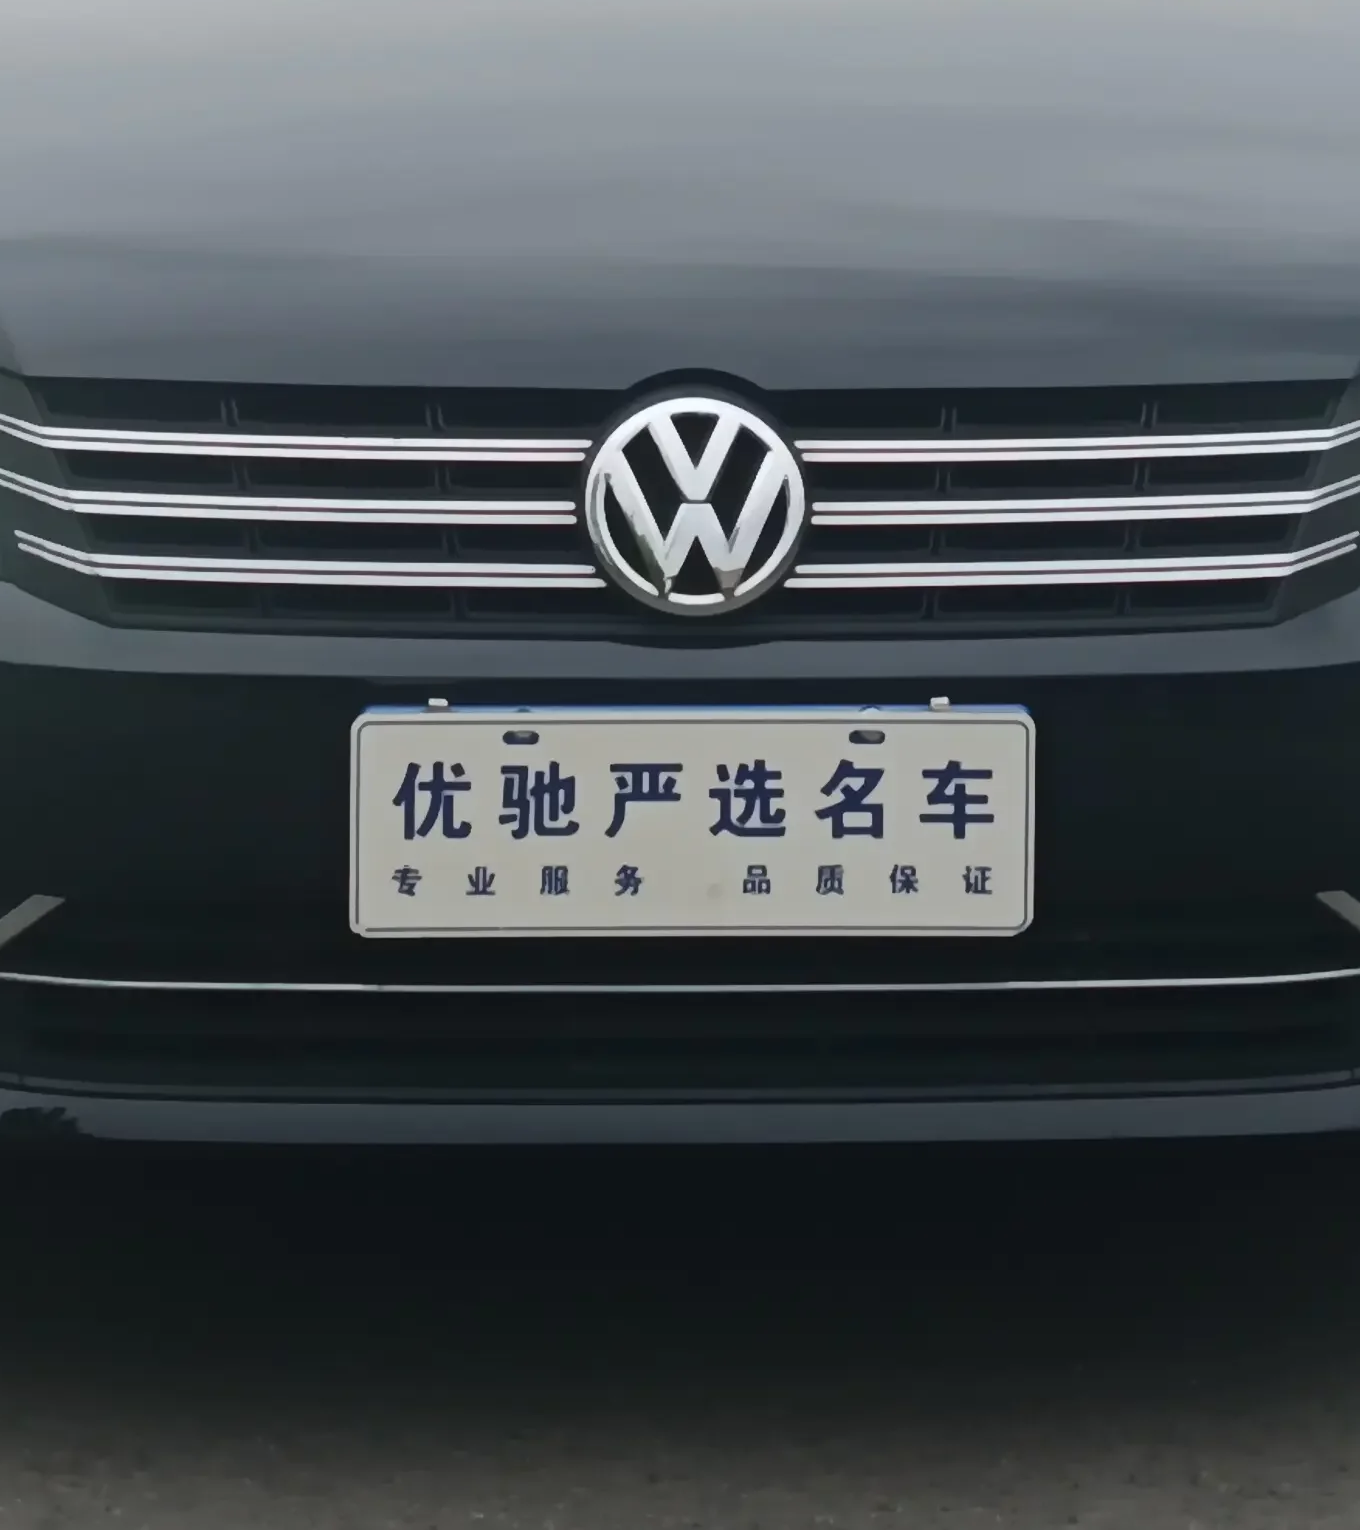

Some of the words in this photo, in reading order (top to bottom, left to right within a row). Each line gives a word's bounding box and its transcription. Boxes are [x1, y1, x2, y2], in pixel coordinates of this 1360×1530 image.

[392, 759, 995, 840] 优驰严选名车
[391, 864, 644, 897] 专业服务
[741, 864, 994, 897] 品质保证
